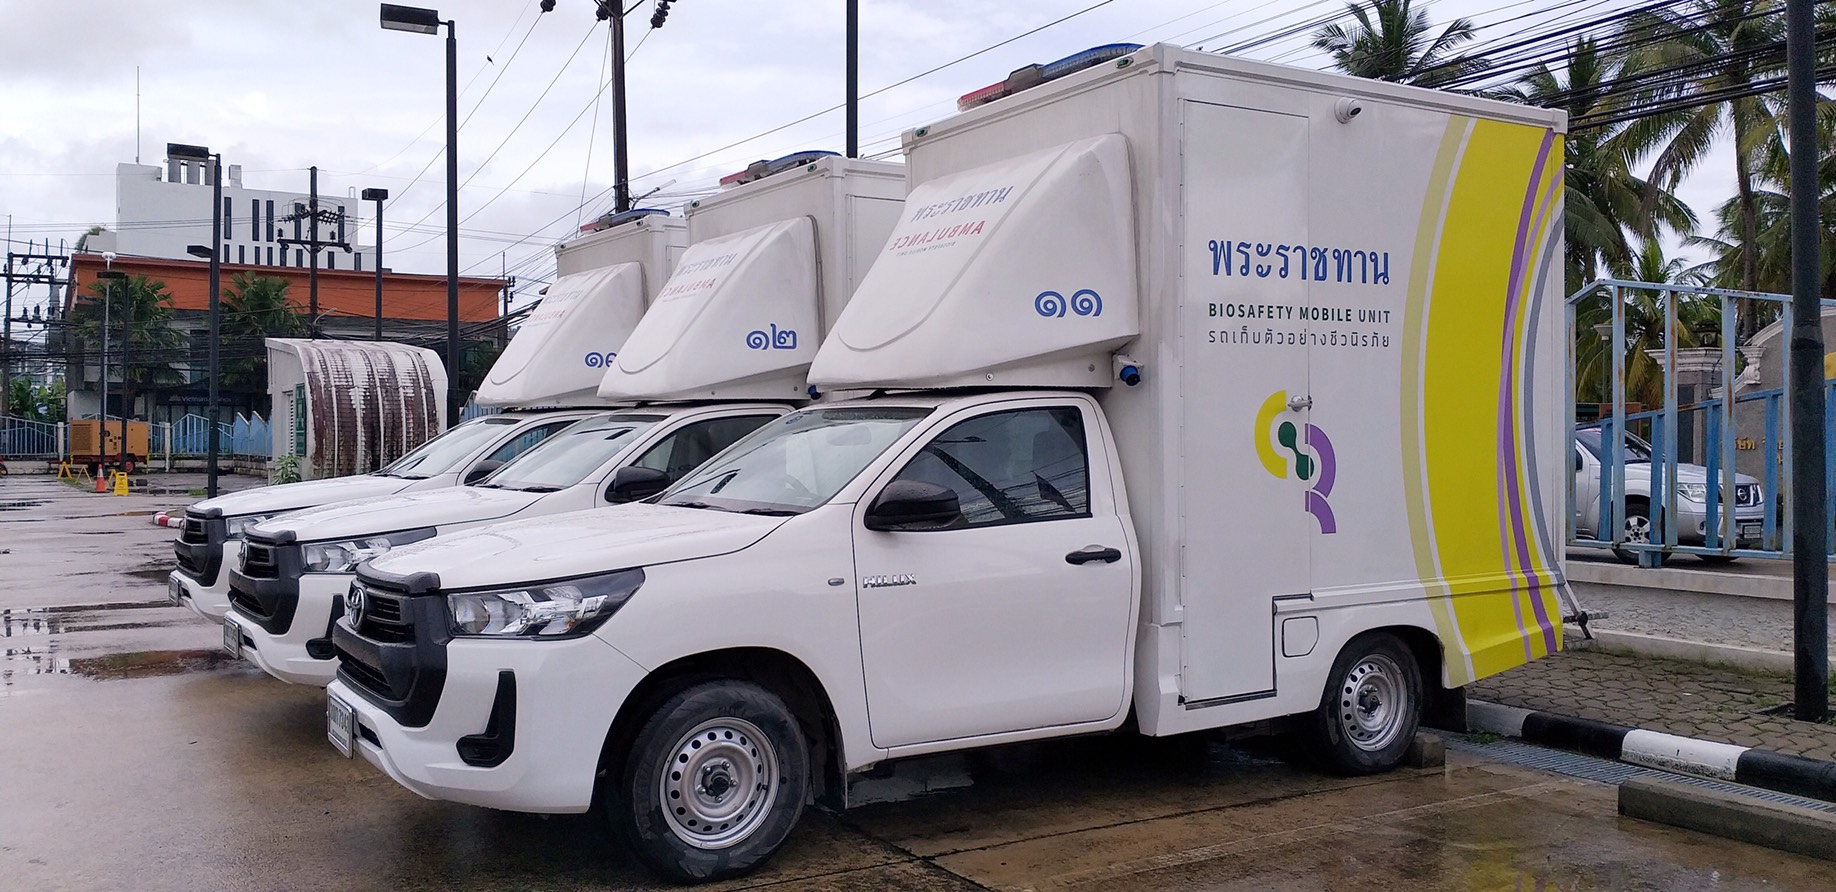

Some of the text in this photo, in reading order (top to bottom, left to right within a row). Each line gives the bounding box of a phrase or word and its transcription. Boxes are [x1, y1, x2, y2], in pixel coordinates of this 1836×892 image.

[910, 185, 1014, 223] พระราชทาน
[1208, 239, 1390, 285] พระราชทาน
[1035, 288, 1103, 318] ๑๑
[1208, 302, 1391, 324] BIOSAFETY MOBILE UNIT
[745, 322, 797, 351] ๑๒
[1208, 325, 1390, 348] รถเก็บตัวอย่างชีวนิรภัย
[862, 573, 917, 589] HILUX
